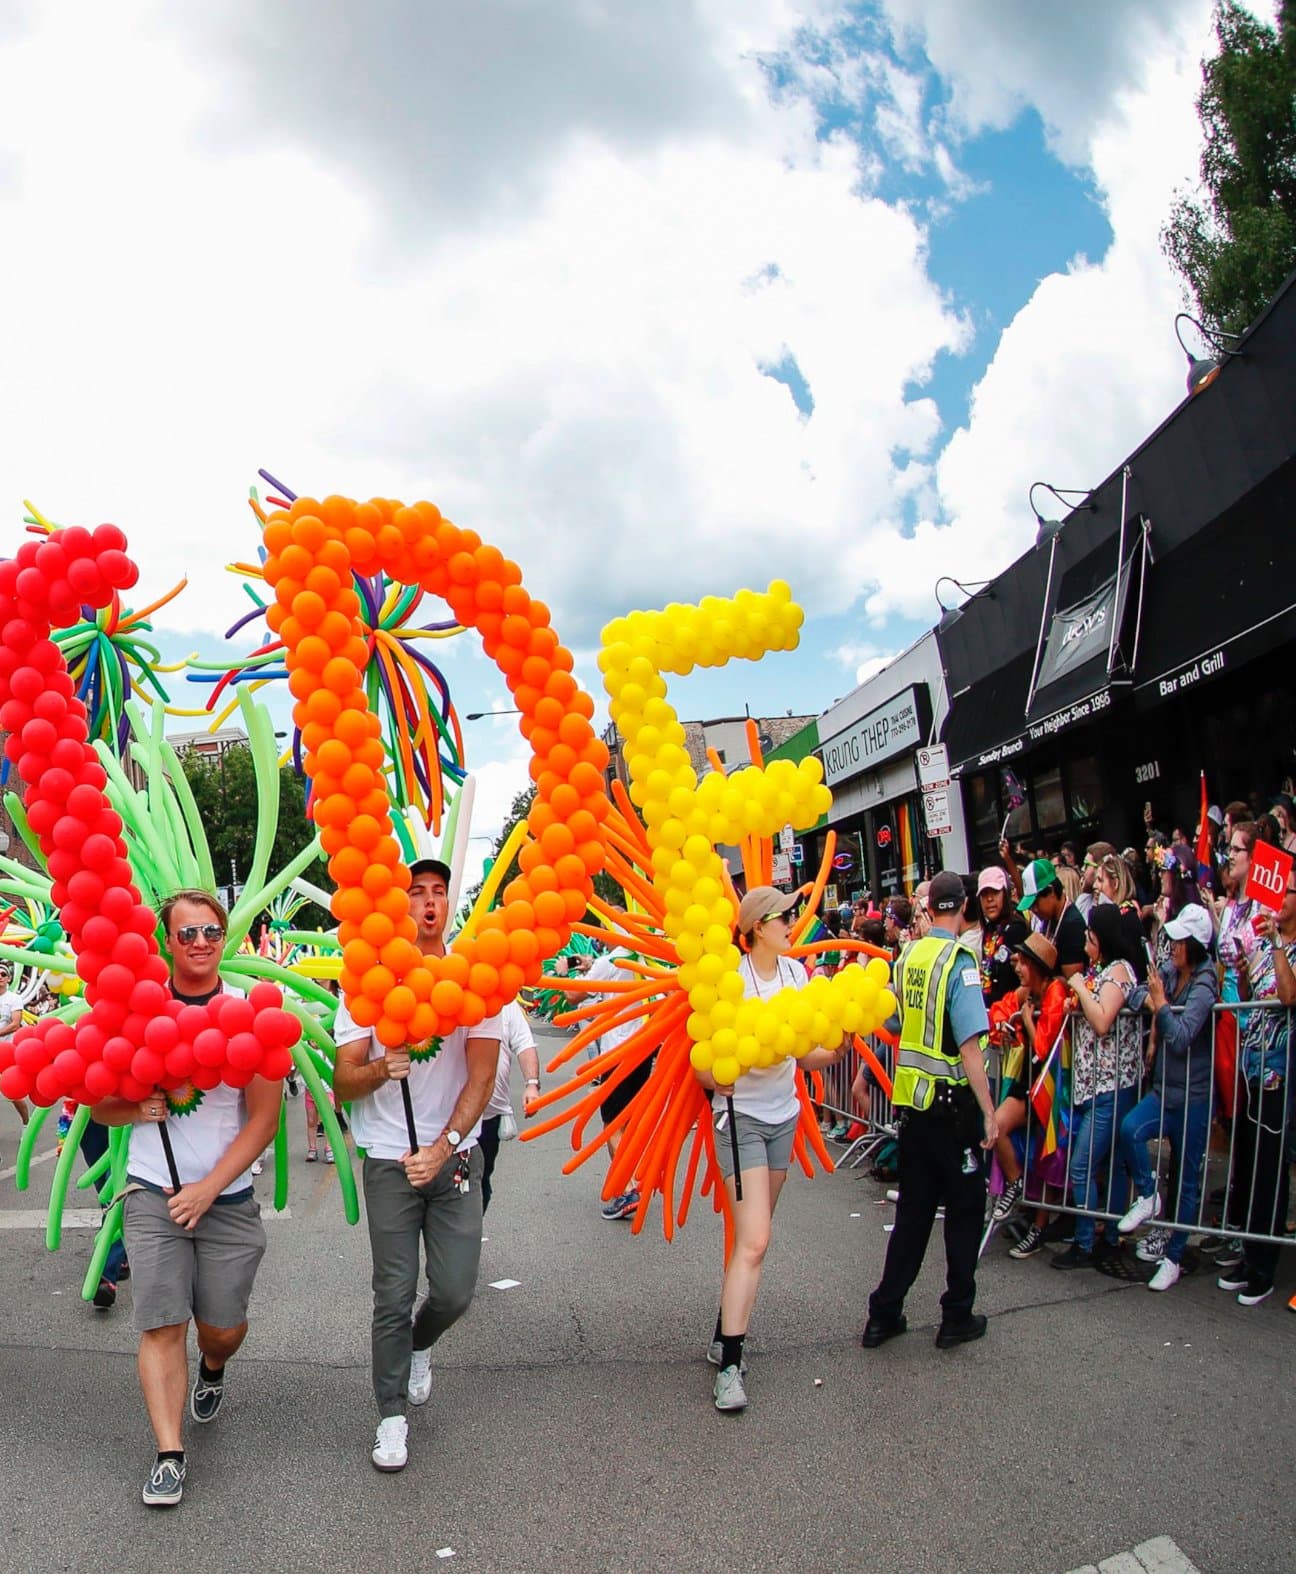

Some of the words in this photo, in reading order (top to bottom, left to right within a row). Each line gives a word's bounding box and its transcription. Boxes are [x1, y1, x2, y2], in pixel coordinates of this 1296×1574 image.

[1159, 678, 1178, 697] Bar
[1179, 664, 1200, 687] and
[1201, 651, 1225, 675] Grill
[1029, 724, 1044, 740] Your
[1071, 704, 1090, 722] Since
[825, 736, 860, 777] KRUNG
[861, 717, 889, 757] THEP
[1135, 760, 1161, 783] 3201
[1251, 860, 1284, 894] mb
